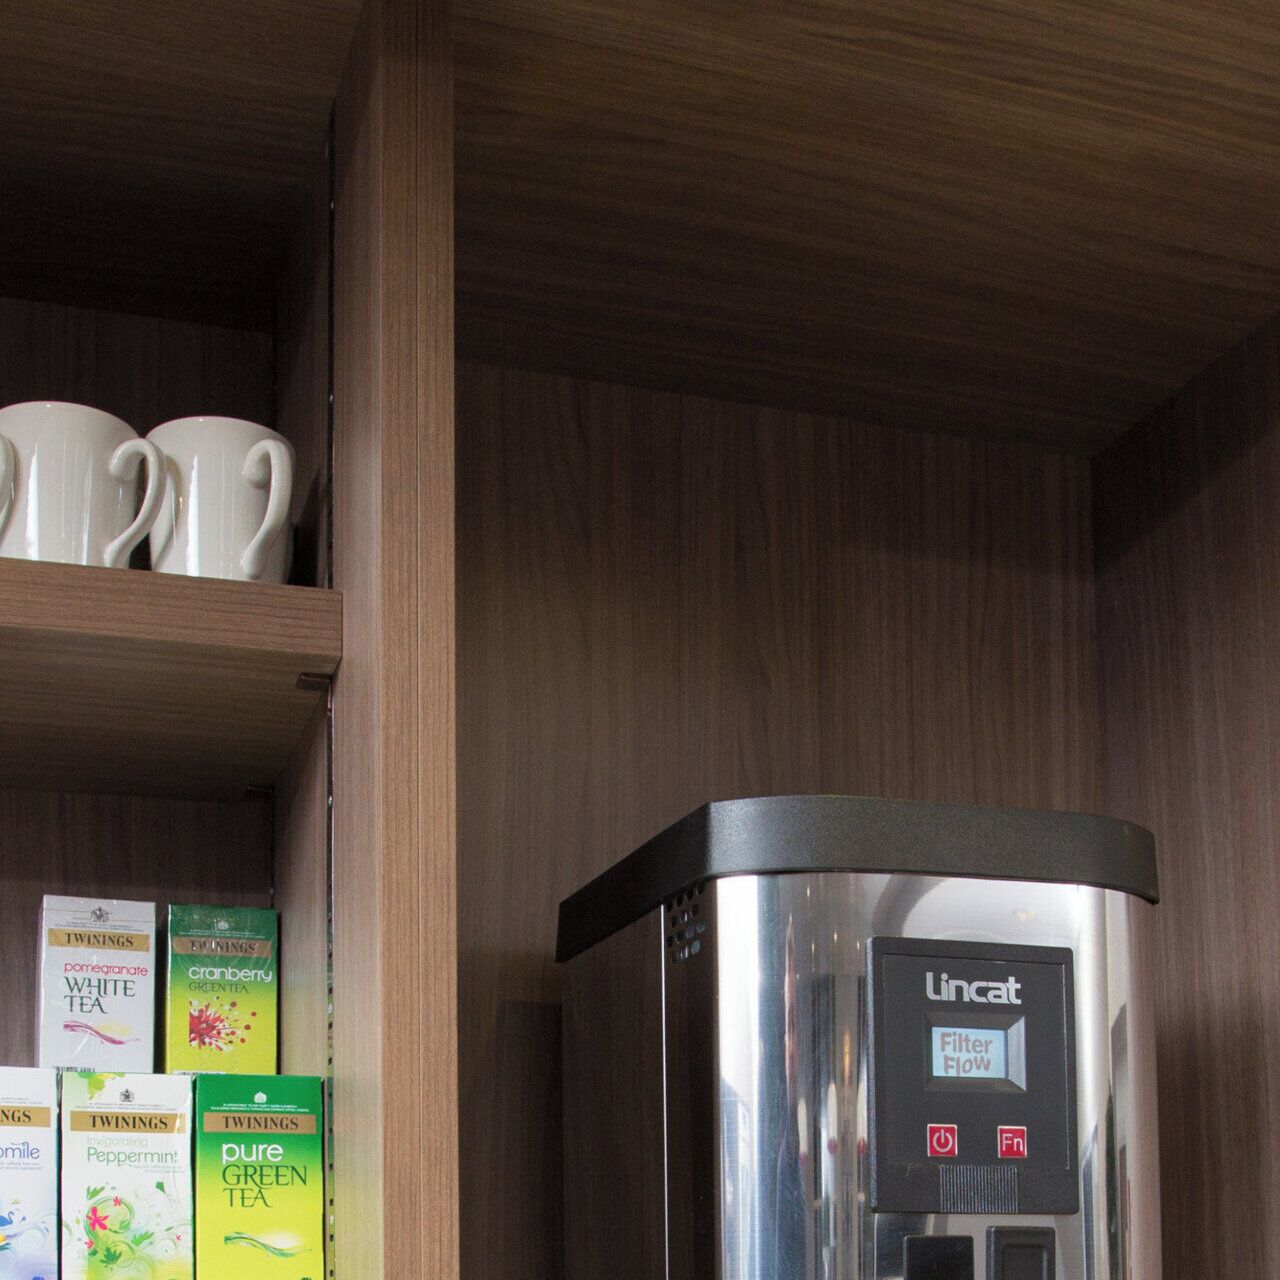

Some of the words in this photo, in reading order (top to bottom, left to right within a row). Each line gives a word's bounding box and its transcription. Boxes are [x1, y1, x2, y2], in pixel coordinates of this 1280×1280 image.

[64, 932, 134, 948] TWININGS
[190, 939, 256, 954] TWININGS
[64, 962, 148, 976] pomegranate
[189, 966, 273, 983] cranberry
[64, 976, 136, 998] WHITE
[189, 981, 226, 994] GREEN
[227, 983, 250, 995] TEA
[64, 995, 109, 1015] TEA
[940, 1031, 994, 1055] Filter
[943, 1055, 992, 1076] Flow
[89, 1114, 168, 1130] TWININGS
[223, 1115, 299, 1131] TWININGS
[86, 1136, 148, 1148] Invigorating
[1002, 1133, 1024, 1152] Fn
[87, 1147, 178, 1166] Peppermint
[222, 1143, 284, 1164] pure
[222, 1164, 308, 1189] GREEN
[223, 1187, 273, 1208] TEA
